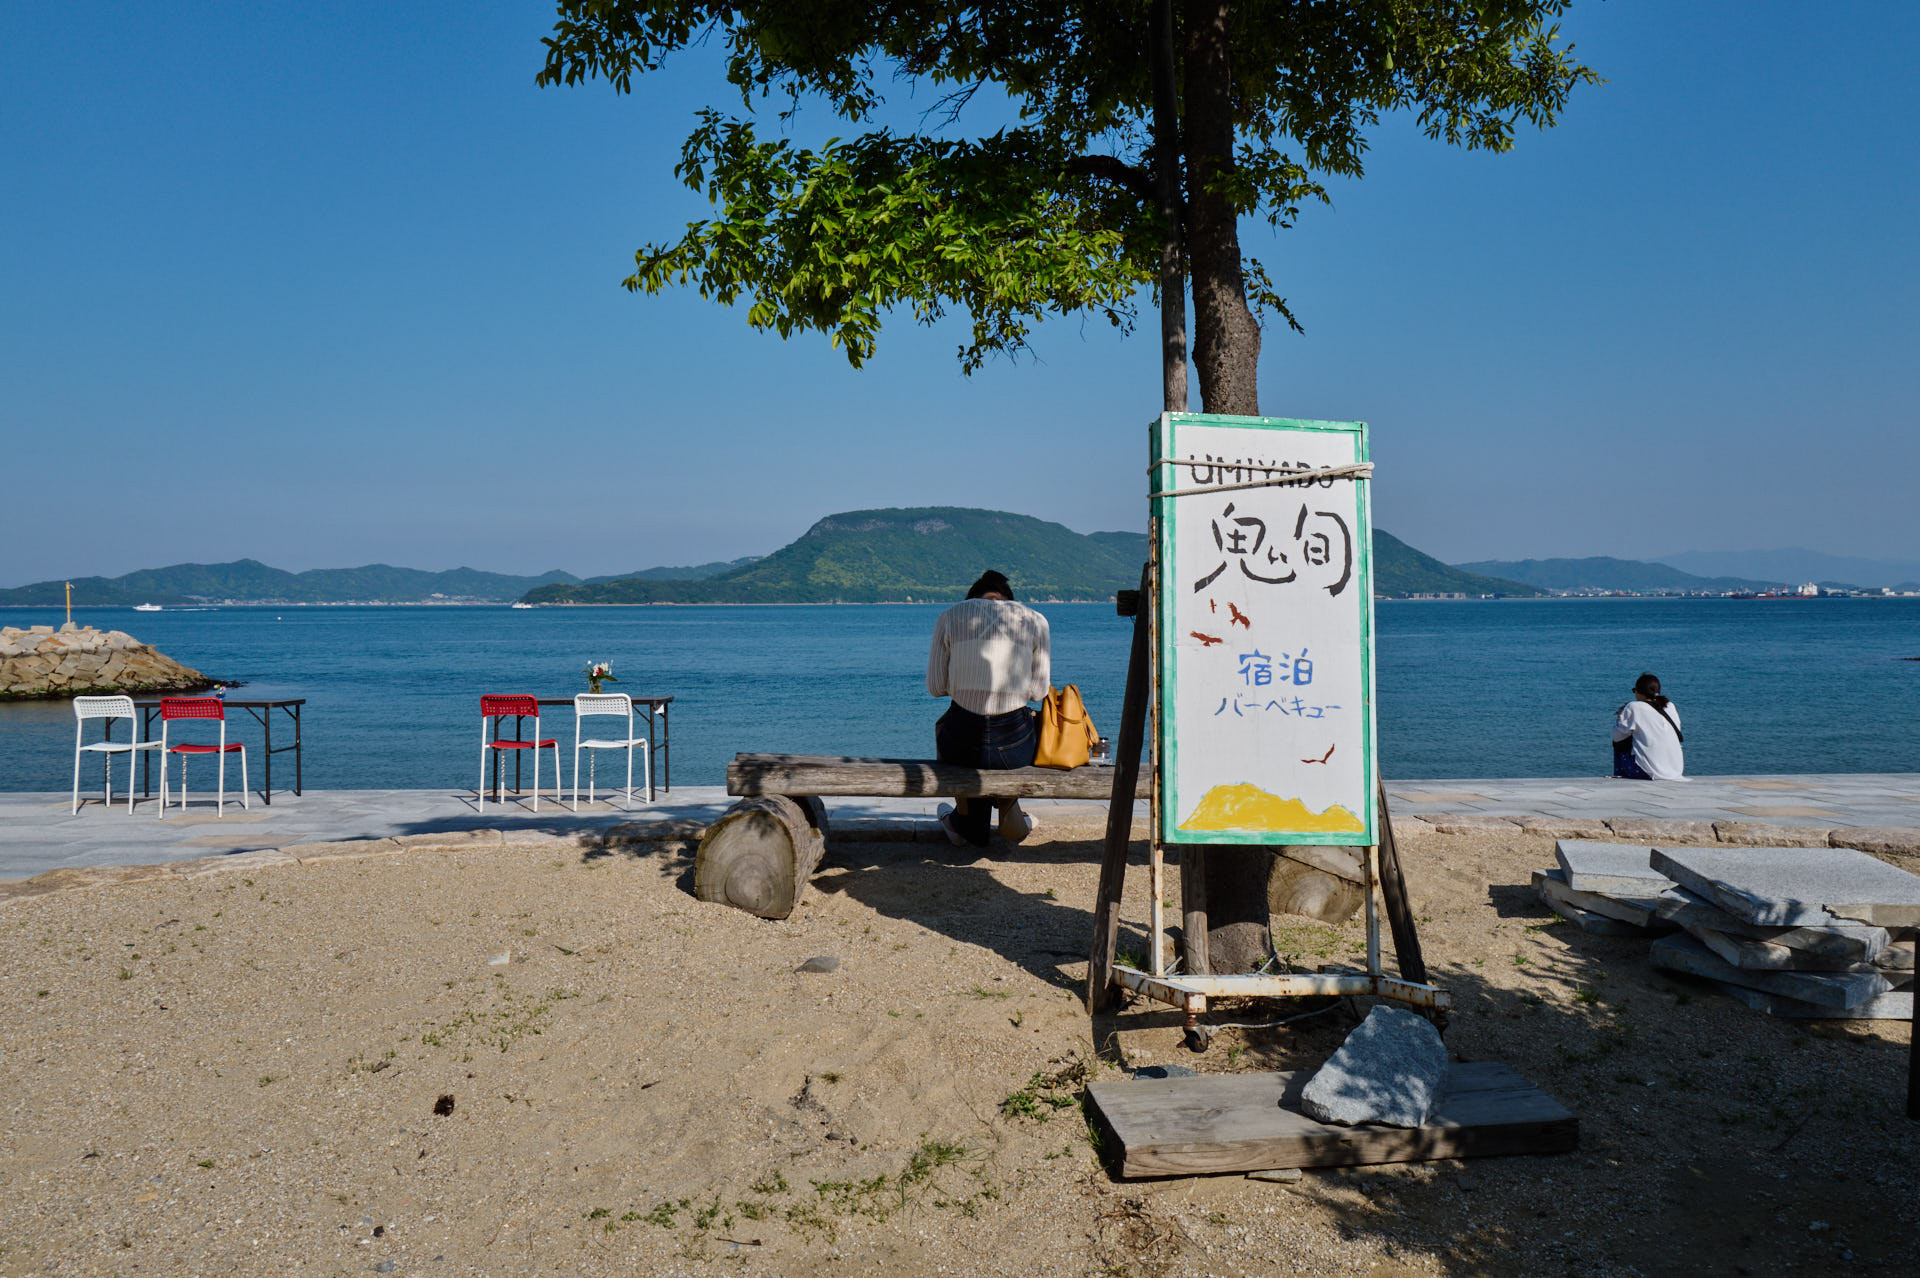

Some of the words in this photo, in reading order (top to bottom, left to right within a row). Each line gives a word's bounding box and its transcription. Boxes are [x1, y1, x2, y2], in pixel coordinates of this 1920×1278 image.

[1190, 454, 1334, 488] UMIYADO
[1238, 648, 1313, 686] 宿泊
[1214, 693, 1342, 719] バーベキュー
